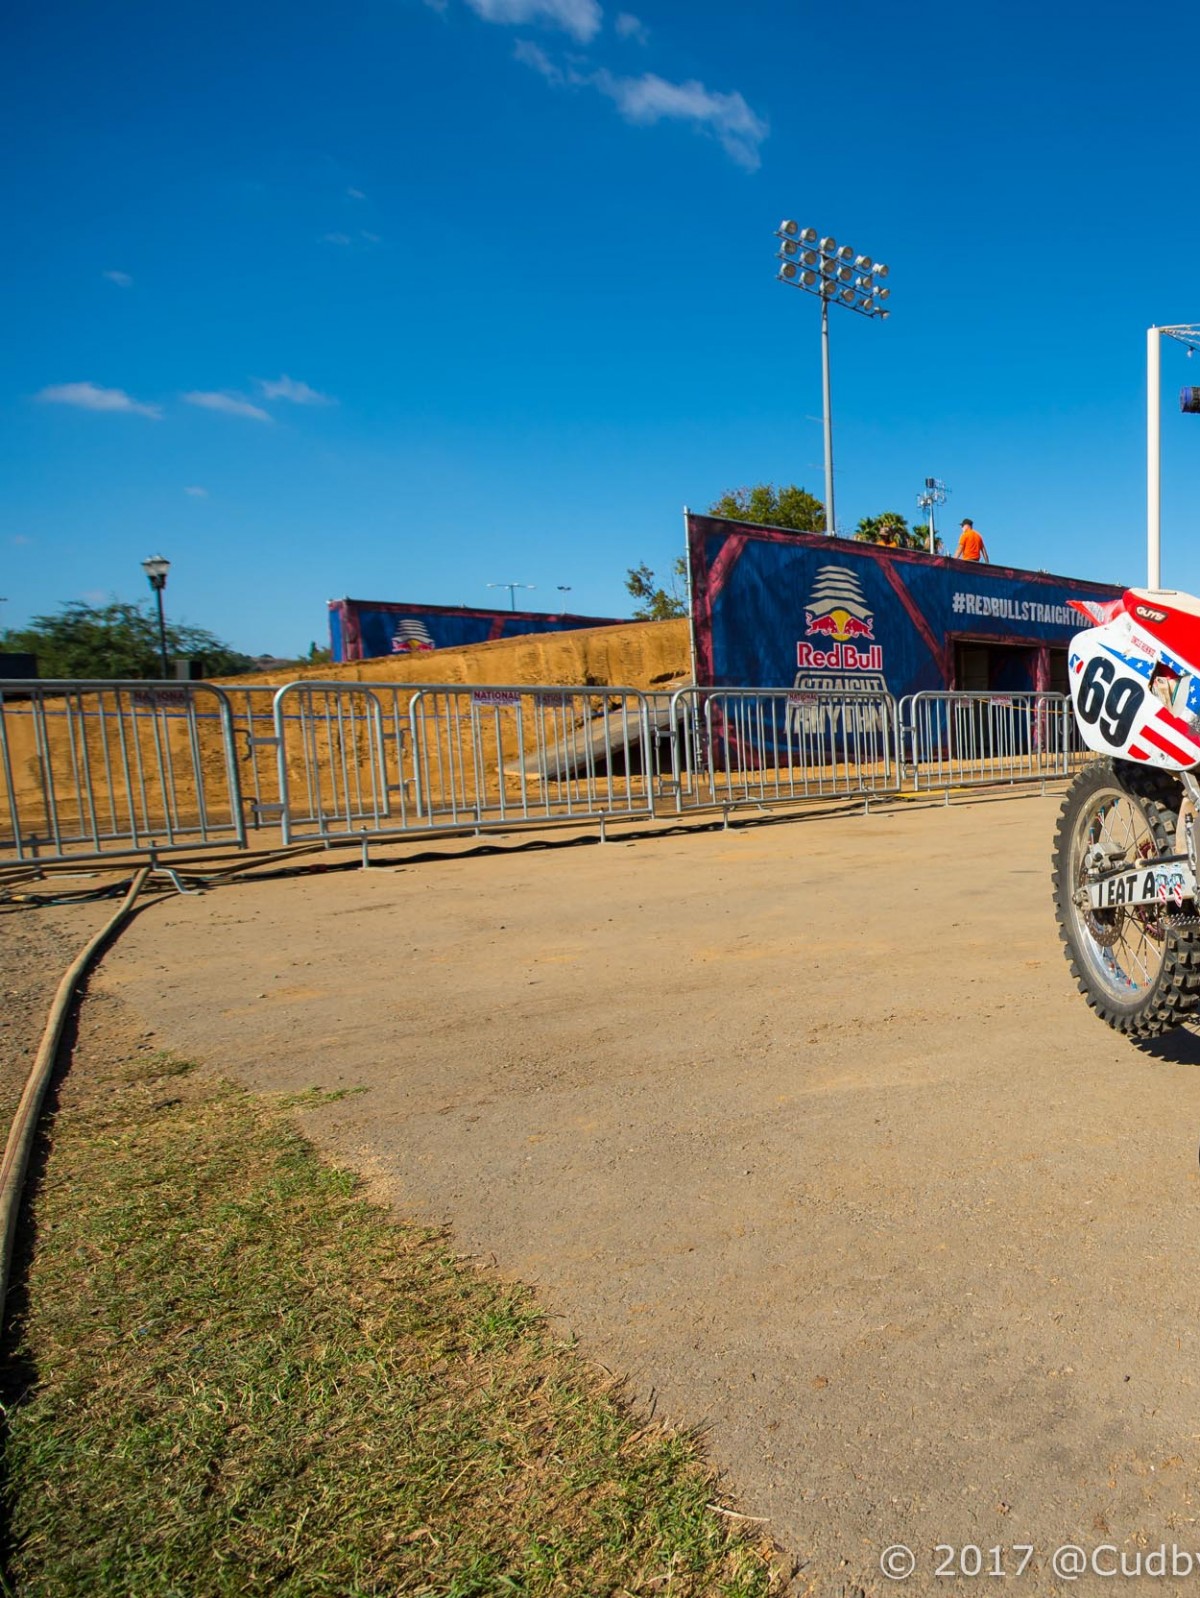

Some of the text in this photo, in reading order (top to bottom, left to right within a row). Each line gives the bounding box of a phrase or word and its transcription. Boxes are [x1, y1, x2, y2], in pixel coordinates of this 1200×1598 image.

[797, 641, 882, 671] Red Bull
[474, 691, 519, 700] NATIONAL
[1077, 656, 1145, 748] 69
[1098, 883, 1103, 907] I
[1108, 874, 1138, 906] EAT
